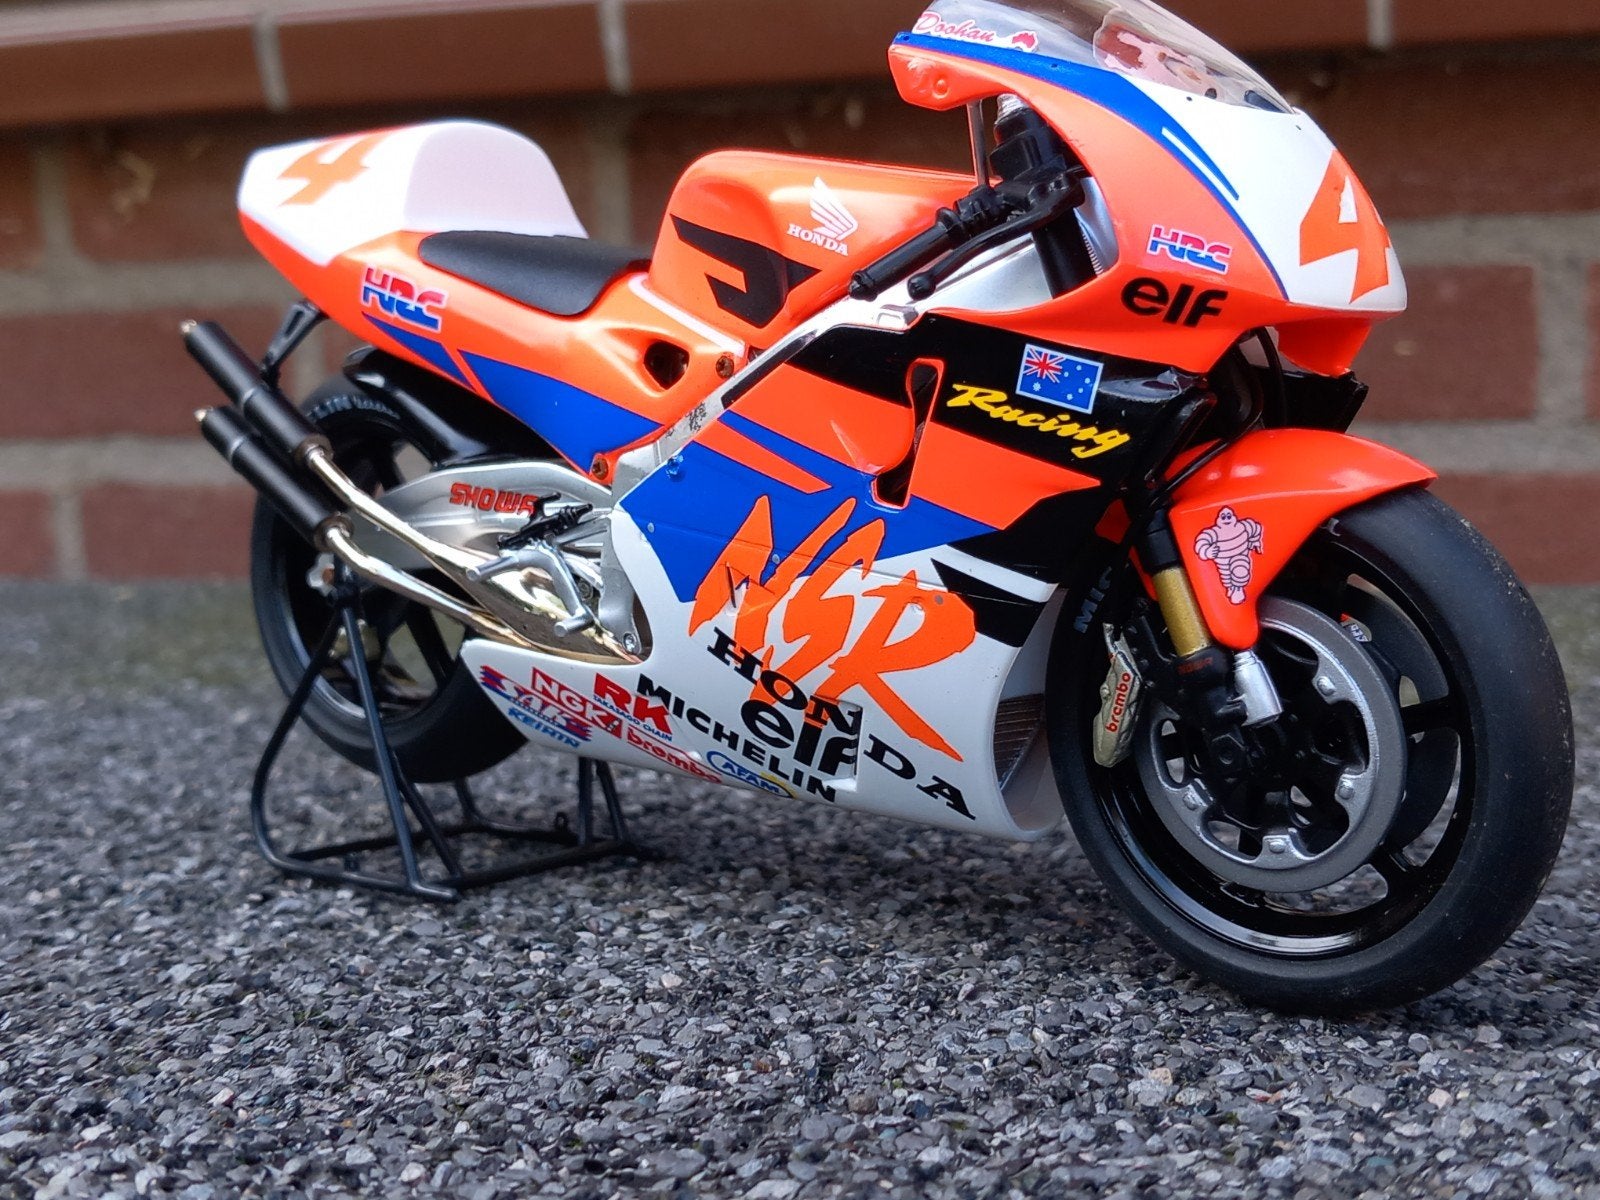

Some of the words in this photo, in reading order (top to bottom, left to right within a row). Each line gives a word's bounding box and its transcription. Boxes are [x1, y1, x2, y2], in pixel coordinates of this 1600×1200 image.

[915, 13, 995, 42] Doohan
[276, 131, 392, 207] 4
[786, 223, 849, 256] HONDA
[1148, 226, 1231, 273] HRC
[1299, 148, 1391, 304] 4
[362, 267, 445, 331] HRC
[1120, 276, 1229, 328] elf
[947, 384, 1131, 459] Racing
[688, 494, 976, 762] NSR
[535, 671, 612, 733] NGK
[594, 673, 673, 734] RK
[643, 723, 673, 742] CHAIN
[706, 626, 976, 820] HONDA
[1105, 672, 1131, 733] brembo
[628, 729, 723, 784] brembo
[637, 673, 836, 803] MICHELIN
[722, 761, 781, 794] AFAM
